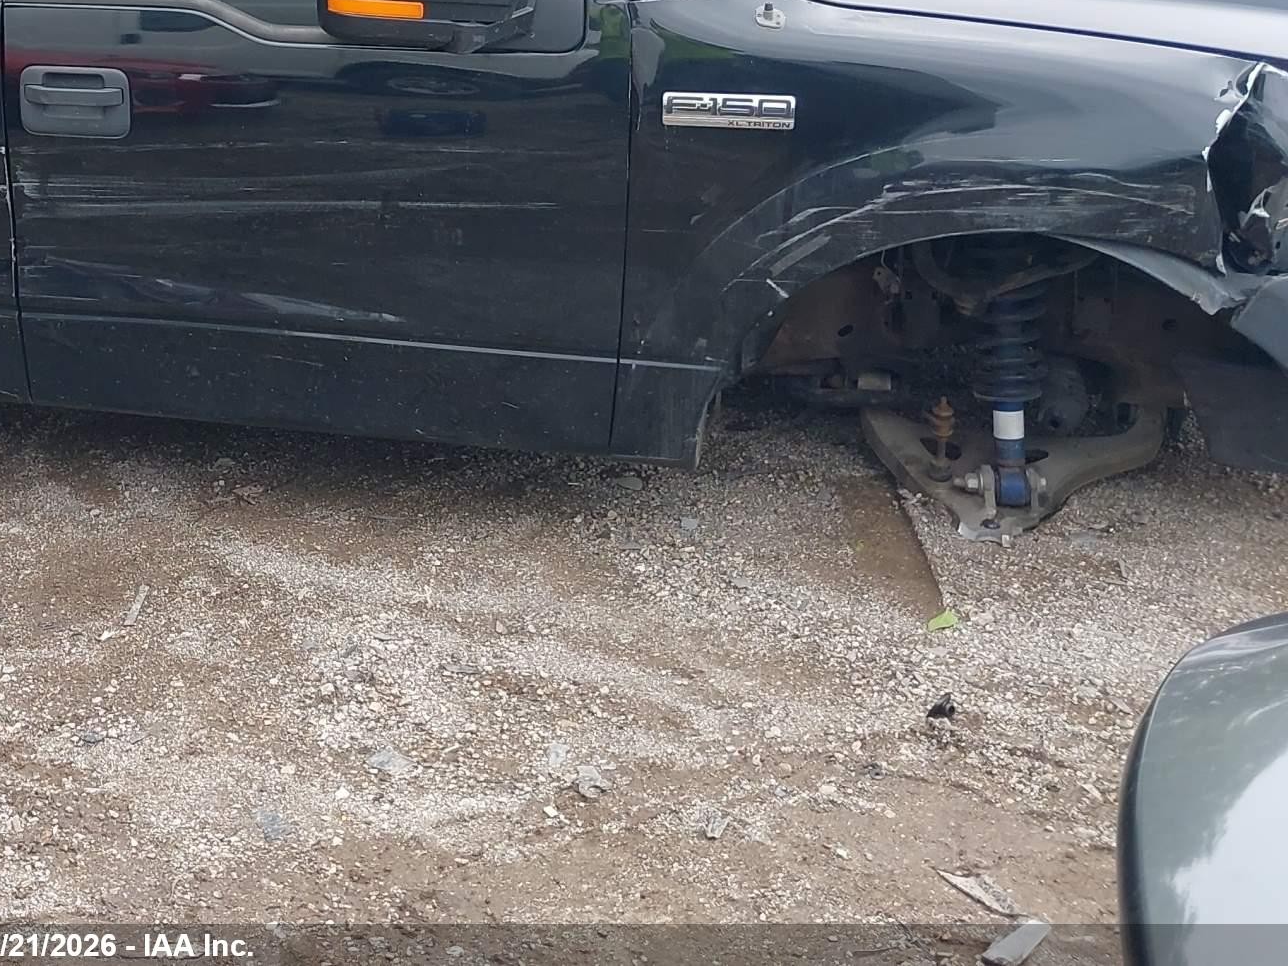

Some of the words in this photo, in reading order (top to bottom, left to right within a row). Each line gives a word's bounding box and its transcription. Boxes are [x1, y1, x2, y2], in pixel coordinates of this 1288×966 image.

[665, 96, 794, 118] F-150
[727, 119, 743, 128] XL
[745, 120, 791, 129] TRITON
